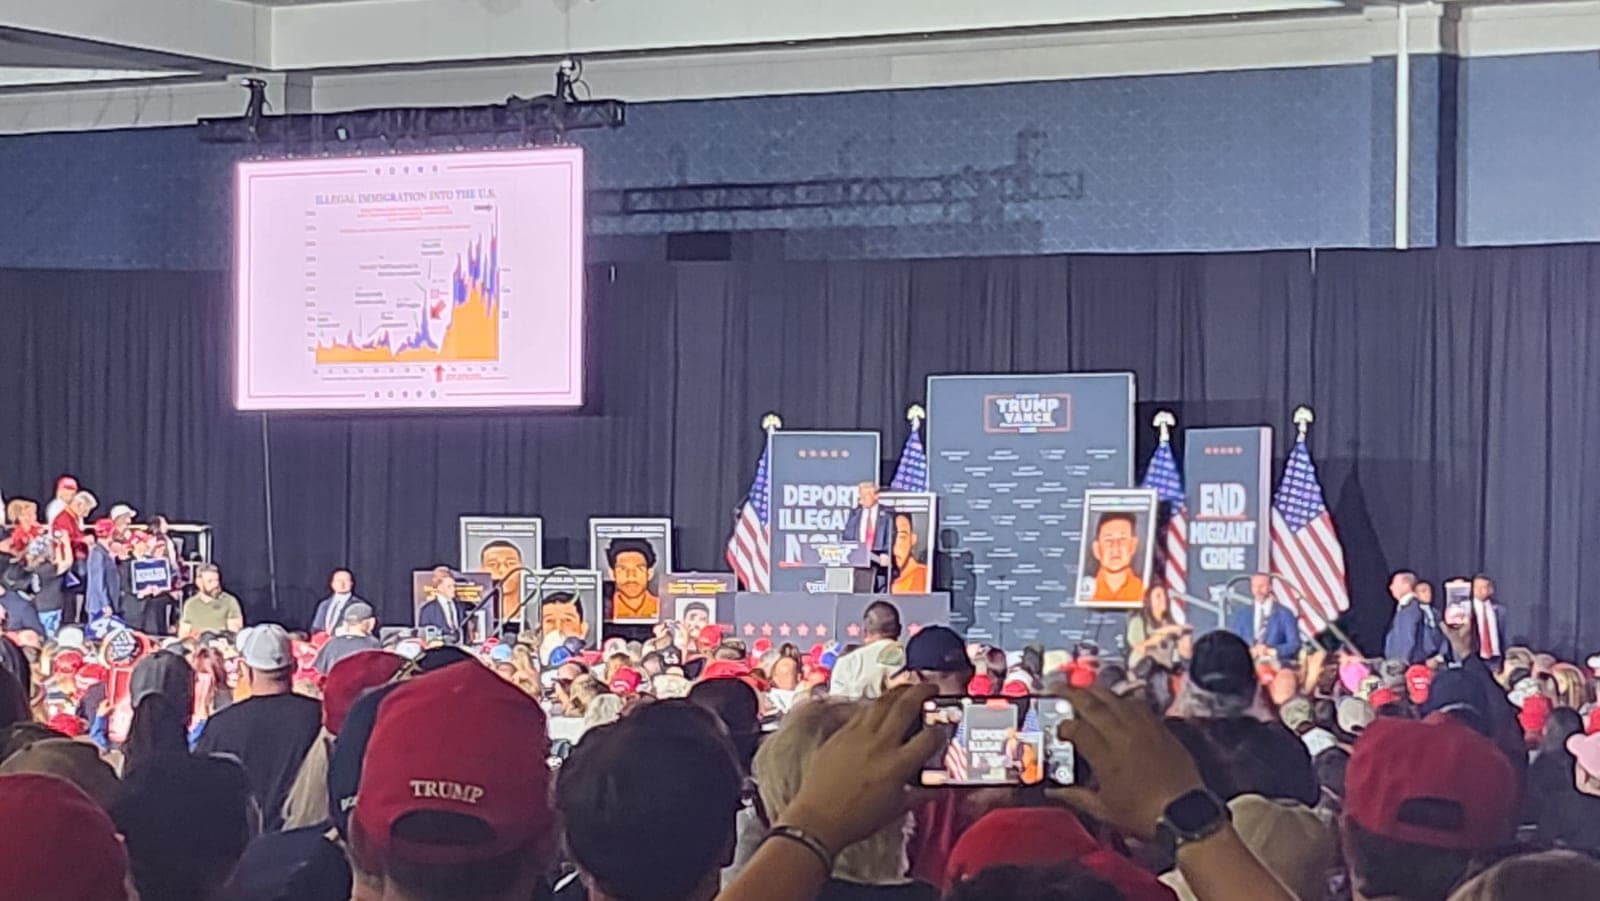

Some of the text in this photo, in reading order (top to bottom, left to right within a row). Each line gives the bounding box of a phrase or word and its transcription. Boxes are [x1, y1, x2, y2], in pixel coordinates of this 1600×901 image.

[315, 193, 355, 205] ILLEGAL
[429, 189, 454, 201] INTO
[996, 398, 1059, 414] TRUMP
[1003, 412, 1052, 424] VANCE
[783, 484, 860, 509] DEPORT
[1200, 482, 1246, 516] END
[1188, 521, 1256, 545] MIGRANT
[1199, 546, 1245, 570] CRIME
[409, 779, 485, 804] TRUMP
